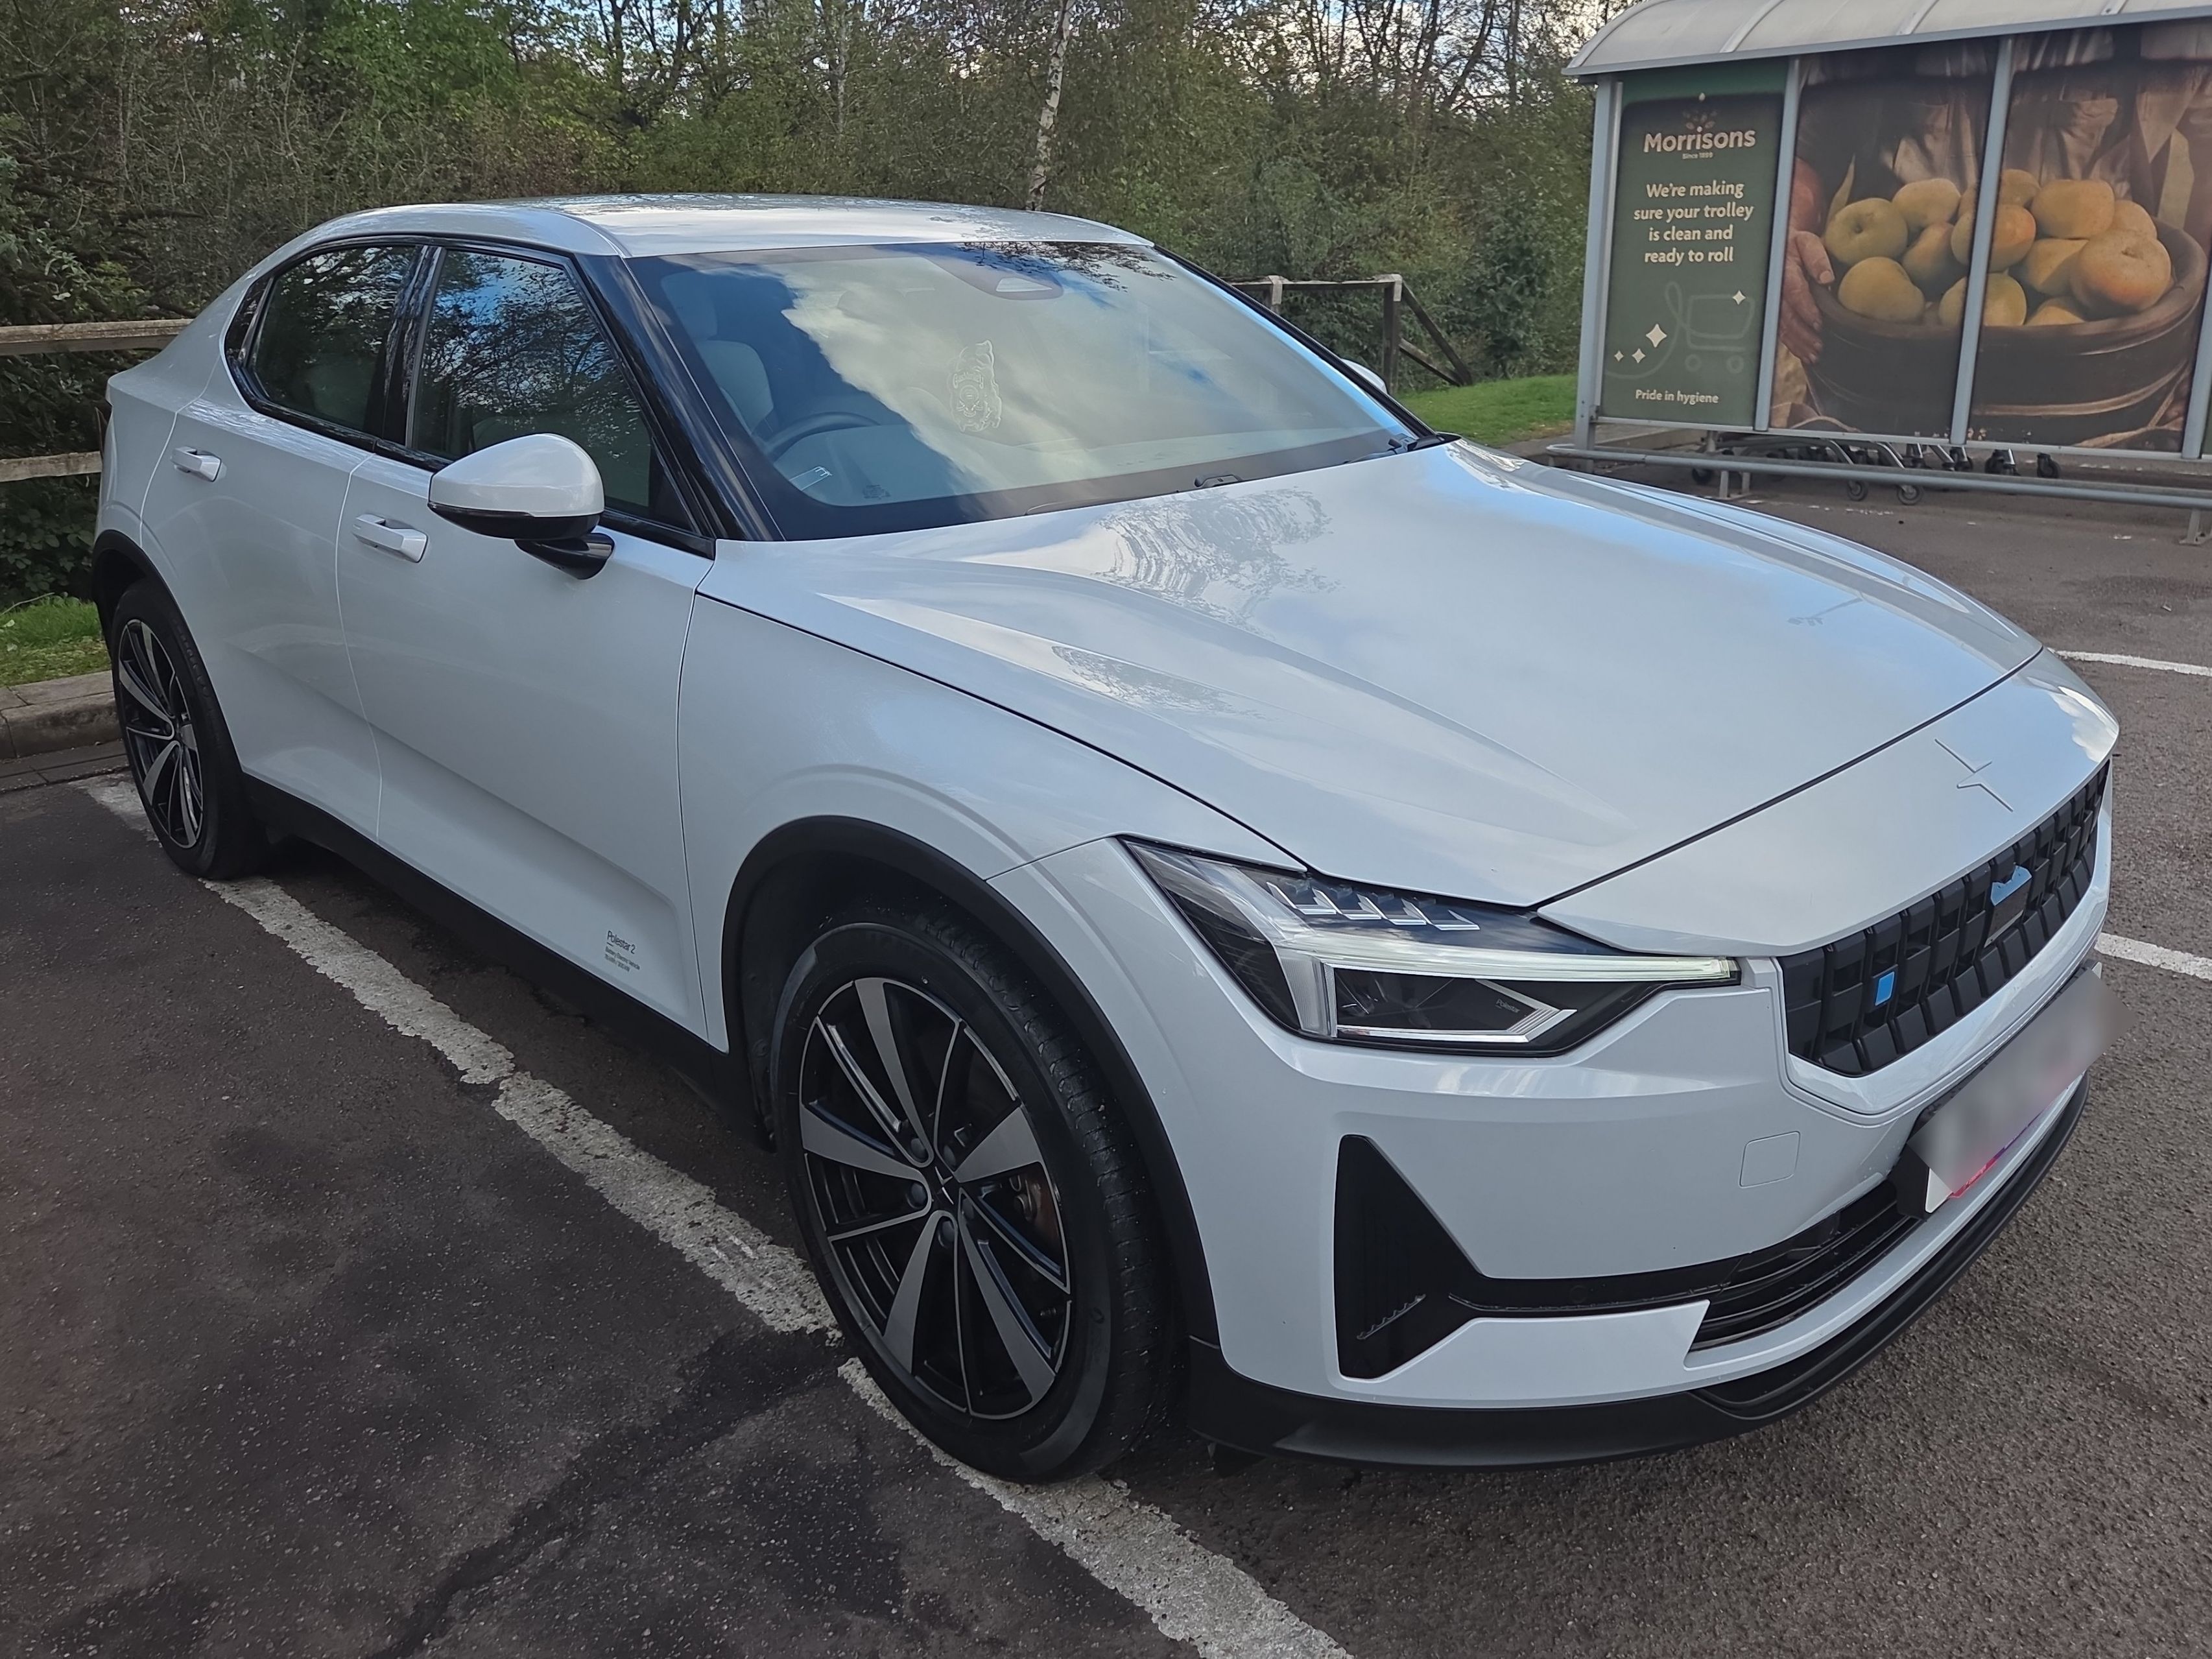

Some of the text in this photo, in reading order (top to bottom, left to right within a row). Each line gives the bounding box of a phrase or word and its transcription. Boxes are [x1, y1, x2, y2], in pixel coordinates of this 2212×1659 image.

[1643, 126, 1756, 153] Morrisons
[1646, 180, 1744, 198] We're making
[1634, 201, 1754, 223] sure your trolley
[1648, 224, 1733, 241] is clean and
[1644, 246, 1733, 266] ready to roll
[1635, 389, 1719, 405] Pride in hygiene
[607, 930, 636, 955] Polestar 2
